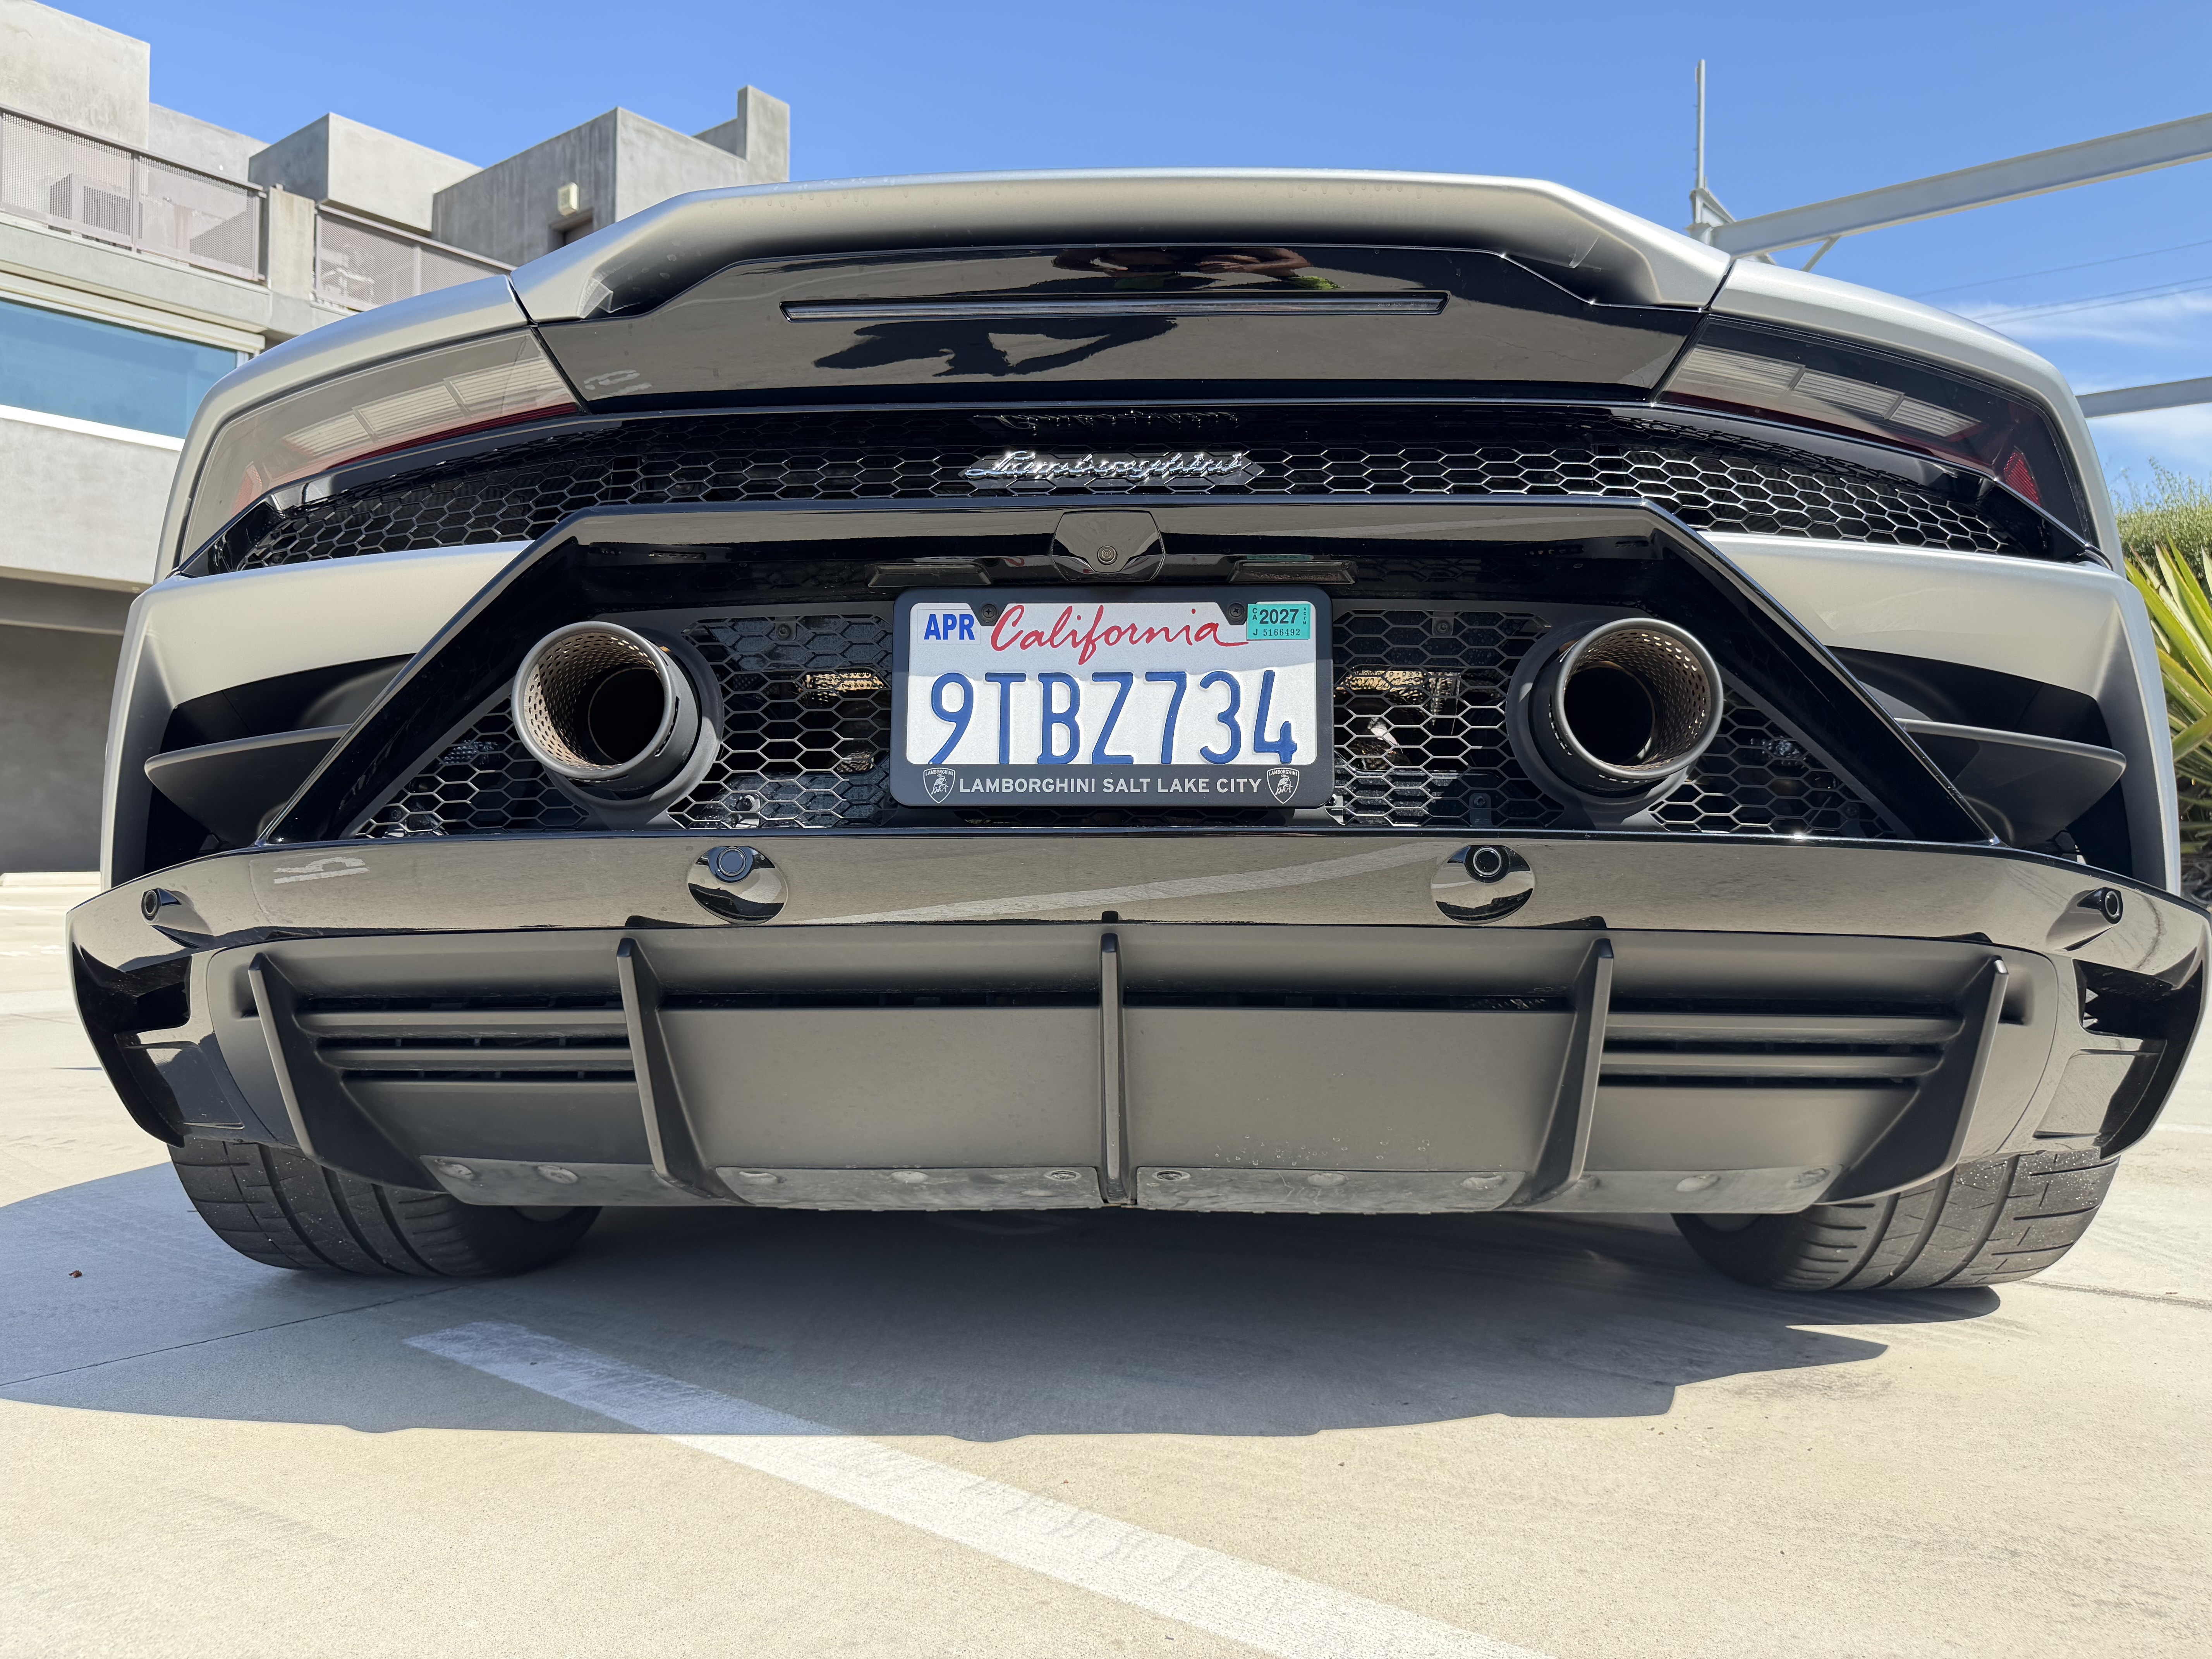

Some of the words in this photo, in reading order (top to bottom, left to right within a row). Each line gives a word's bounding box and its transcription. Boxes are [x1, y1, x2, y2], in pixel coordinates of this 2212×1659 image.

[964, 450, 1242, 480] Lamborghini
[924, 614, 975, 641] APR
[1252, 608, 1257, 620] CA
[1259, 608, 1299, 624] 2027
[991, 605, 1249, 665] California
[929, 670, 1298, 765] 9TBZ734
[960, 778, 1095, 793] LAMBORGHINI
[1103, 778, 1151, 793] SALT
[1158, 778, 1209, 793] LAKE
[1216, 778, 1262, 793] CITY
